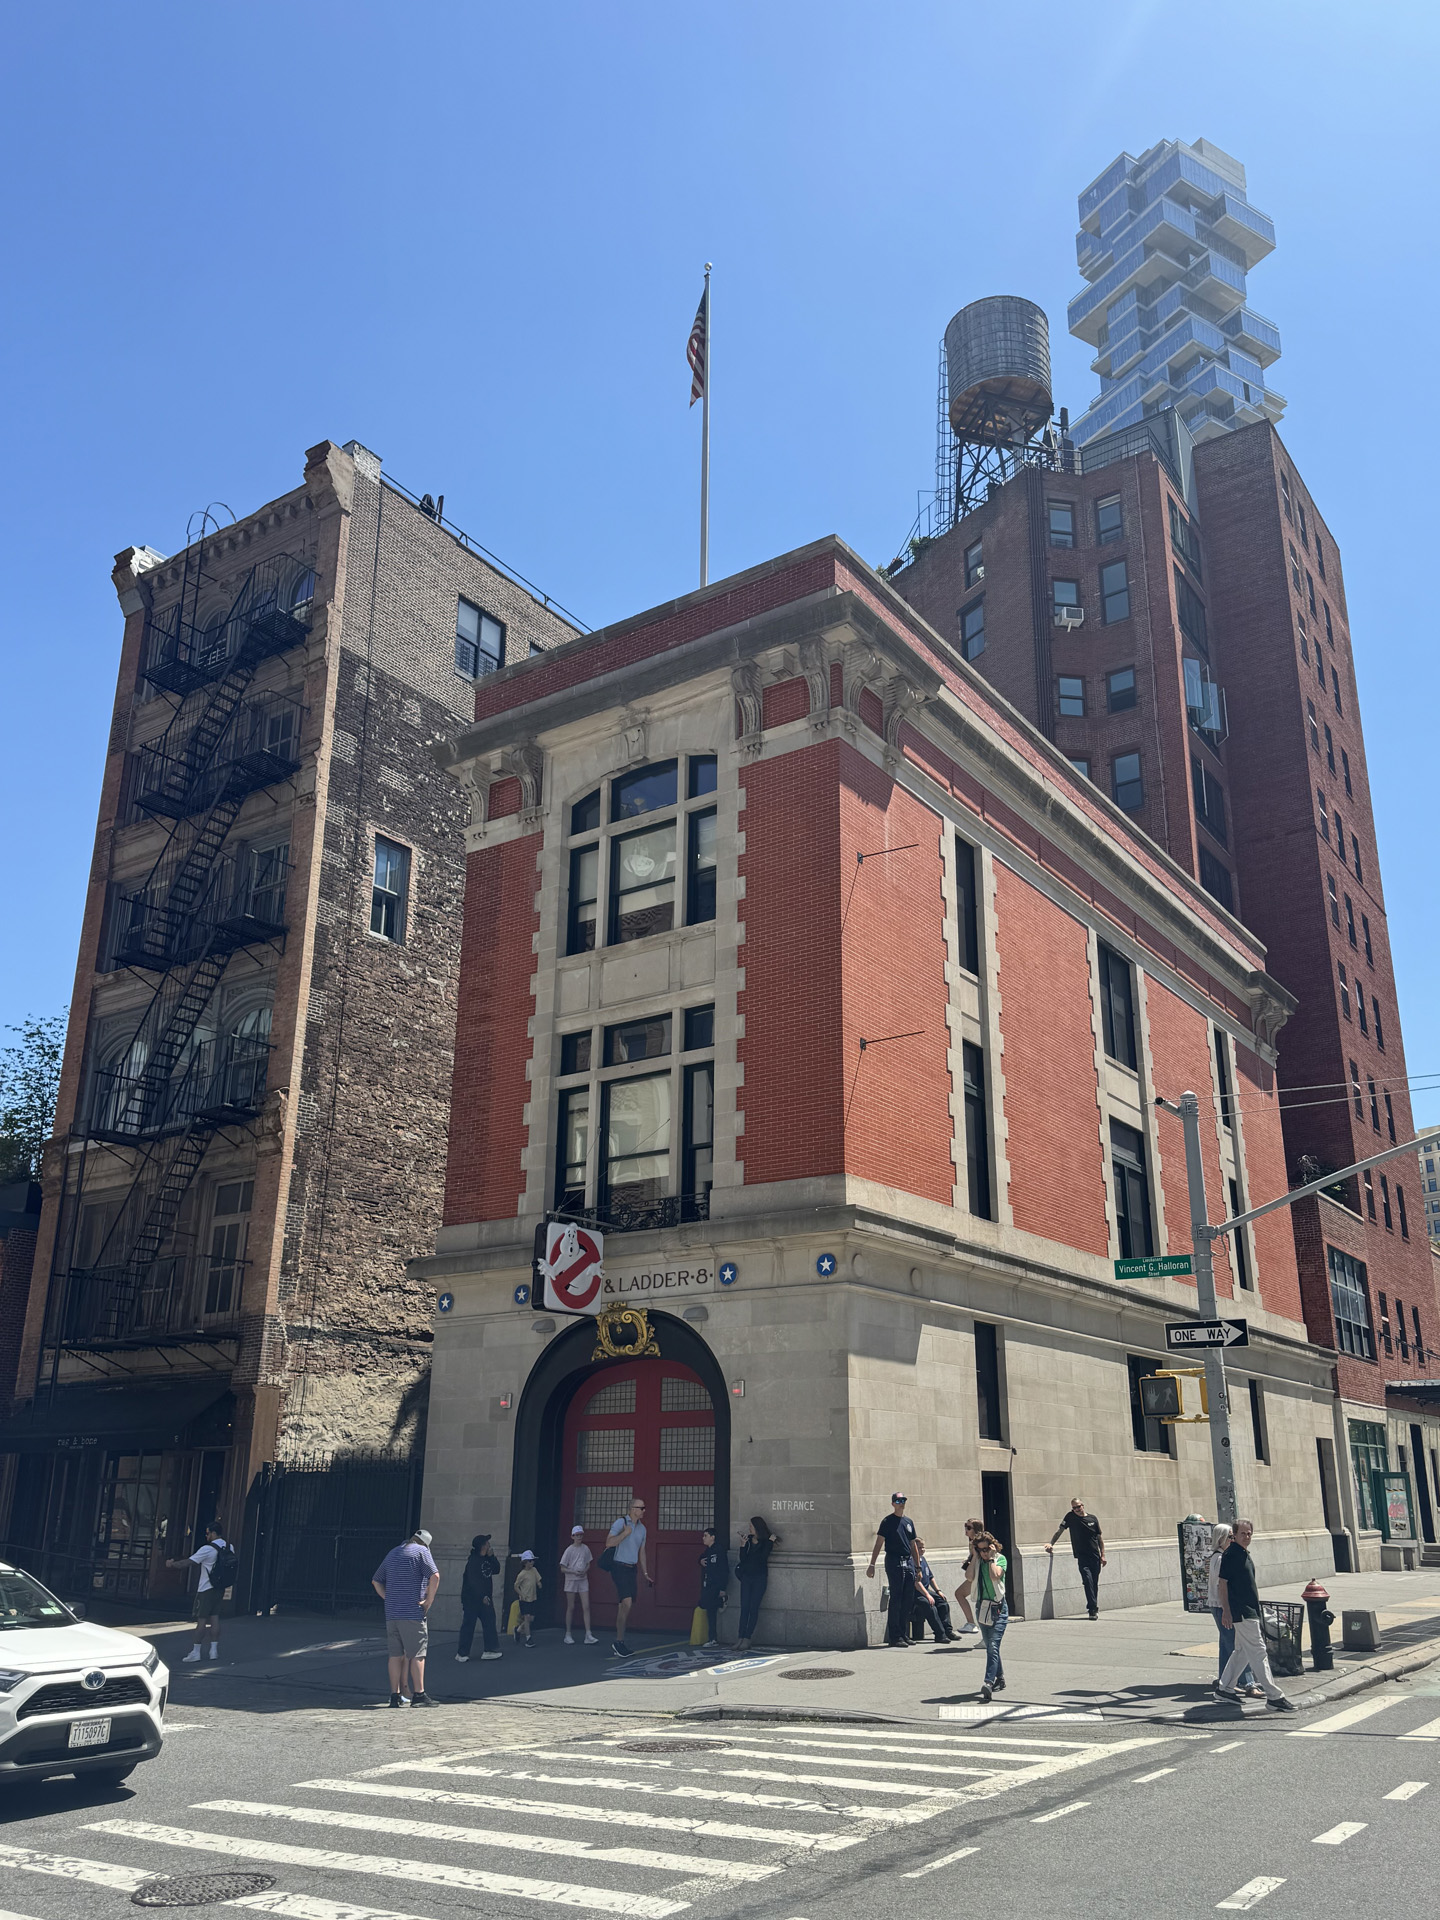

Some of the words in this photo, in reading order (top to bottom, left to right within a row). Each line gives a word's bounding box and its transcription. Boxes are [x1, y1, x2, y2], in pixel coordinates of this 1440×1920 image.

[1119, 1263, 1146, 1274] Vincent
[1148, 1263, 1156, 1272] G.
[1158, 1261, 1189, 1271] Halloran
[604, 1279, 615, 1293] &
[1175, 1330, 1196, 1341] ONE
[1207, 1328, 1231, 1340] WAY
[772, 1500, 815, 1511] ENTRANCE
[73, 1725, 106, 1741] T115097C
